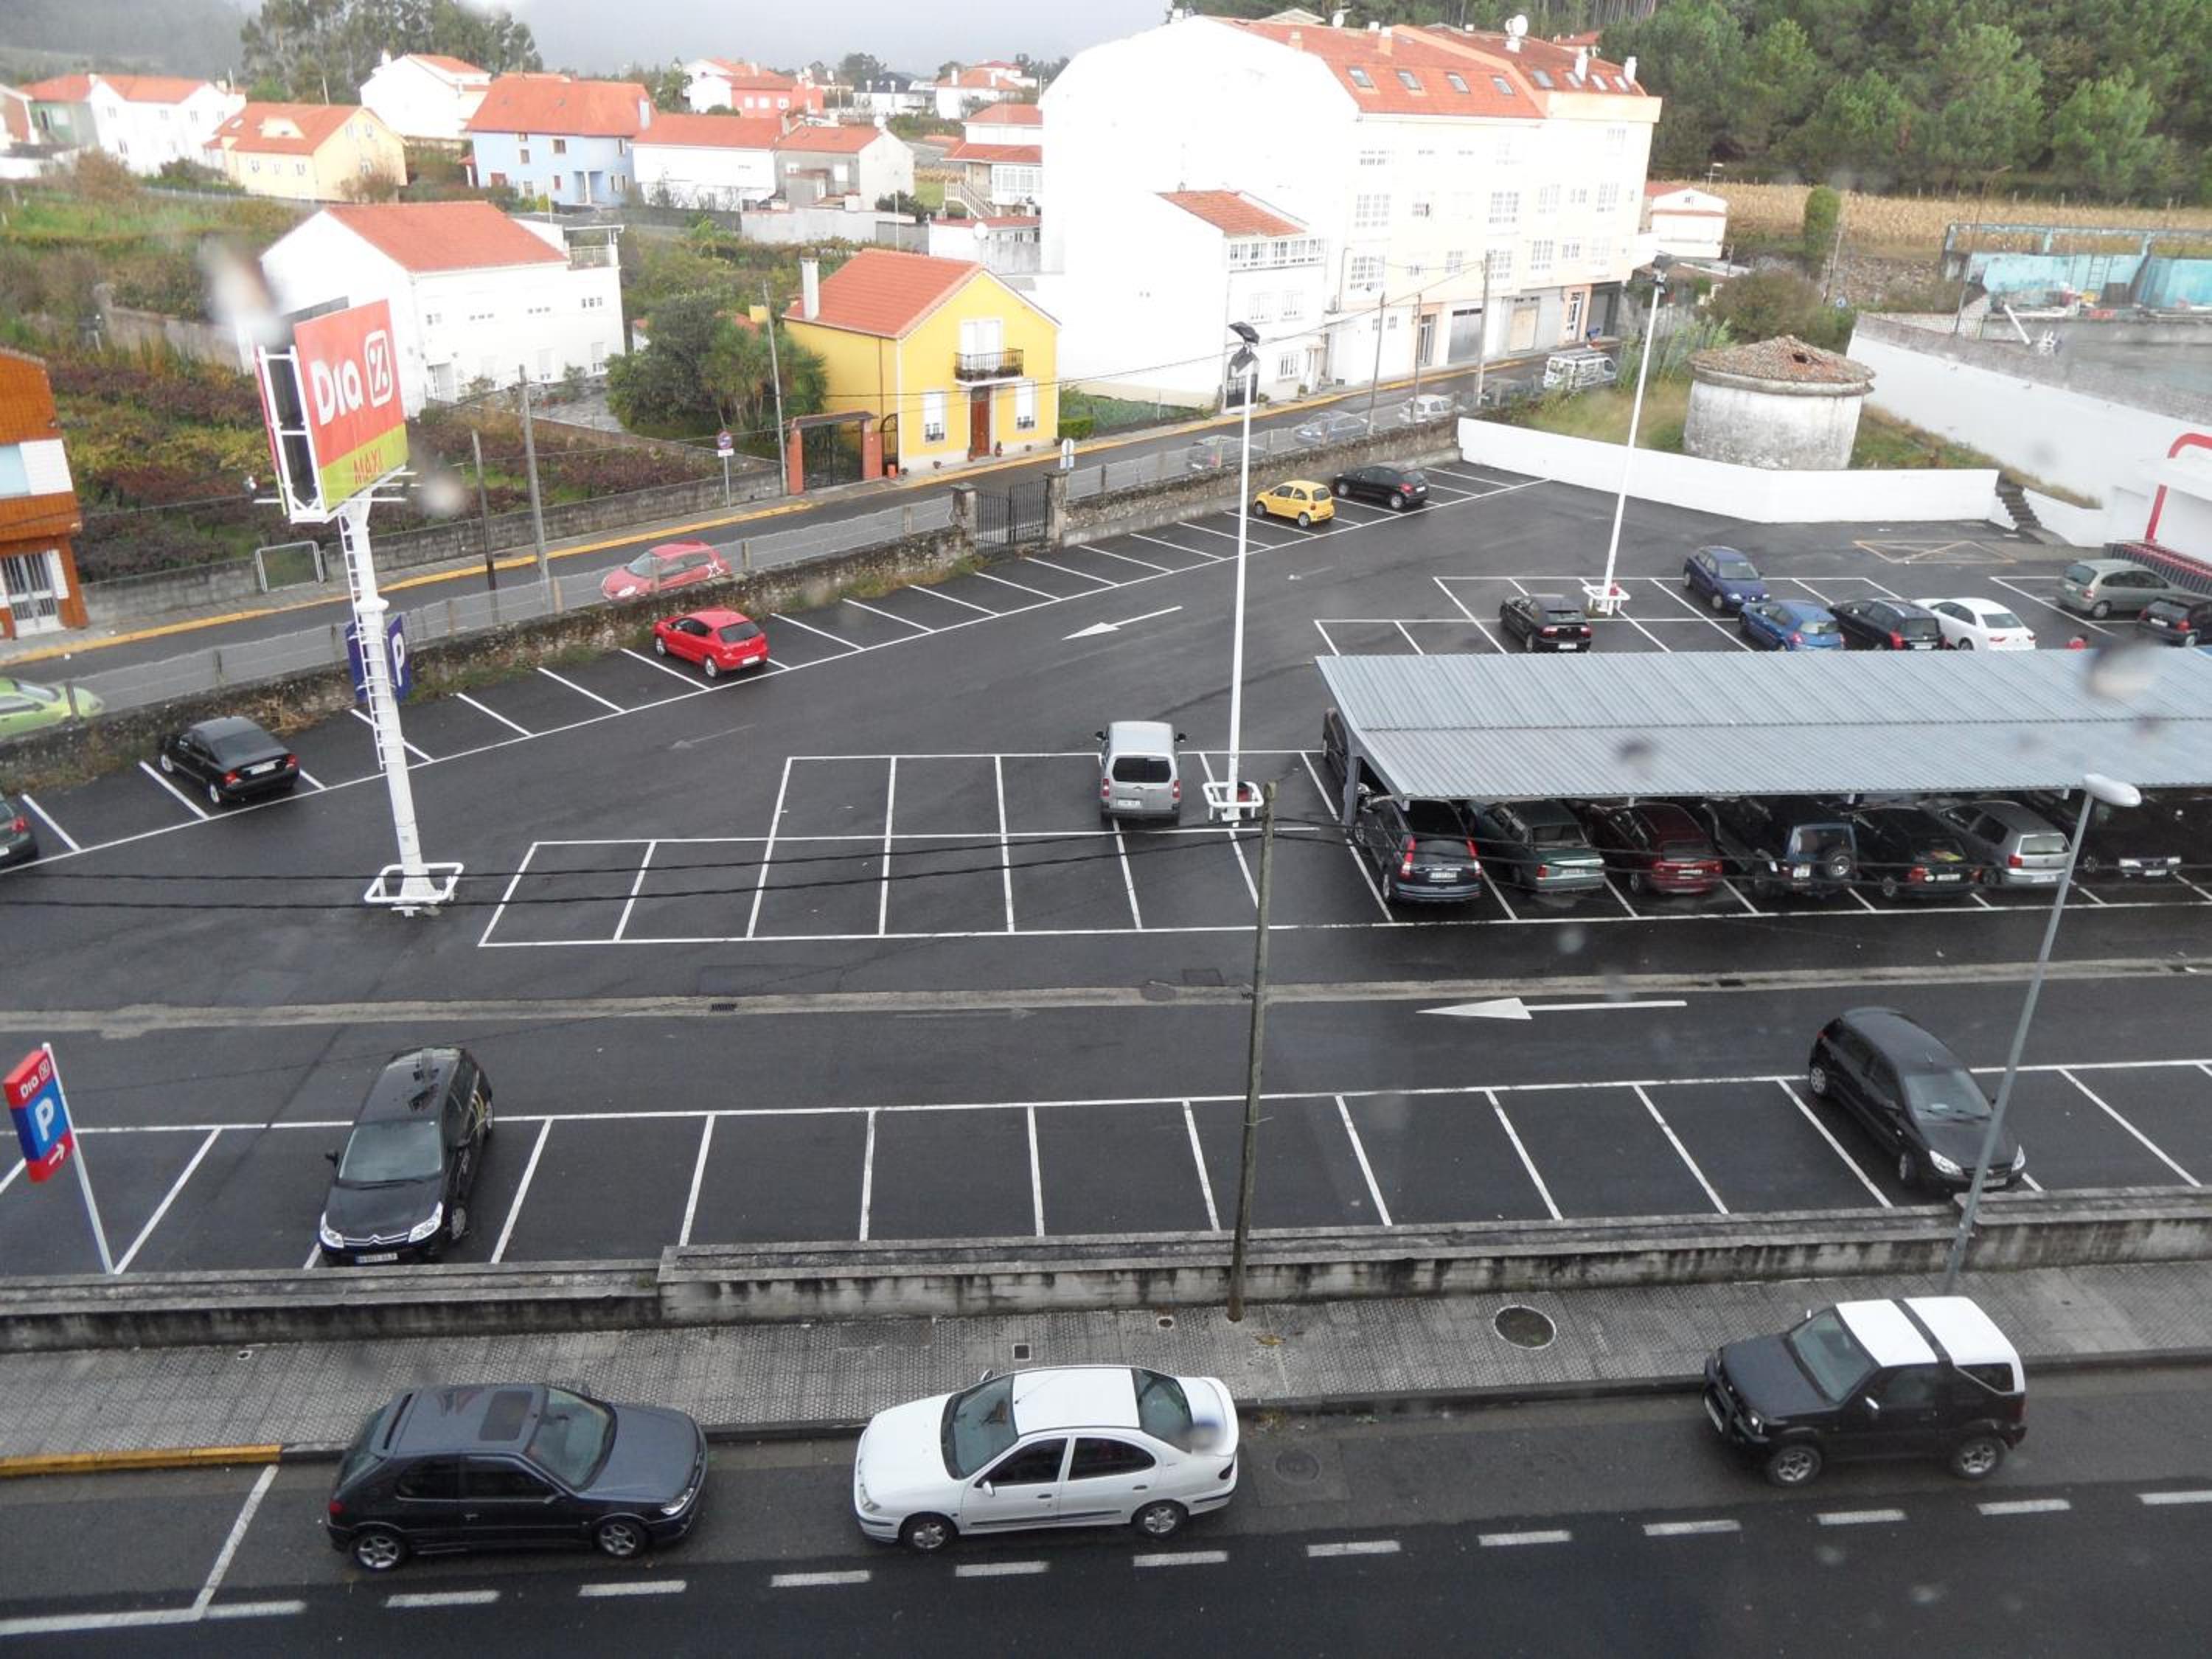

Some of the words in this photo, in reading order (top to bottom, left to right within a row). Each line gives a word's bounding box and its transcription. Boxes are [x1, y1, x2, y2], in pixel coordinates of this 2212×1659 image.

[353, 448, 383, 484] MAXI
[392, 633, 405, 687] P
[35, 1098, 55, 1141] P
